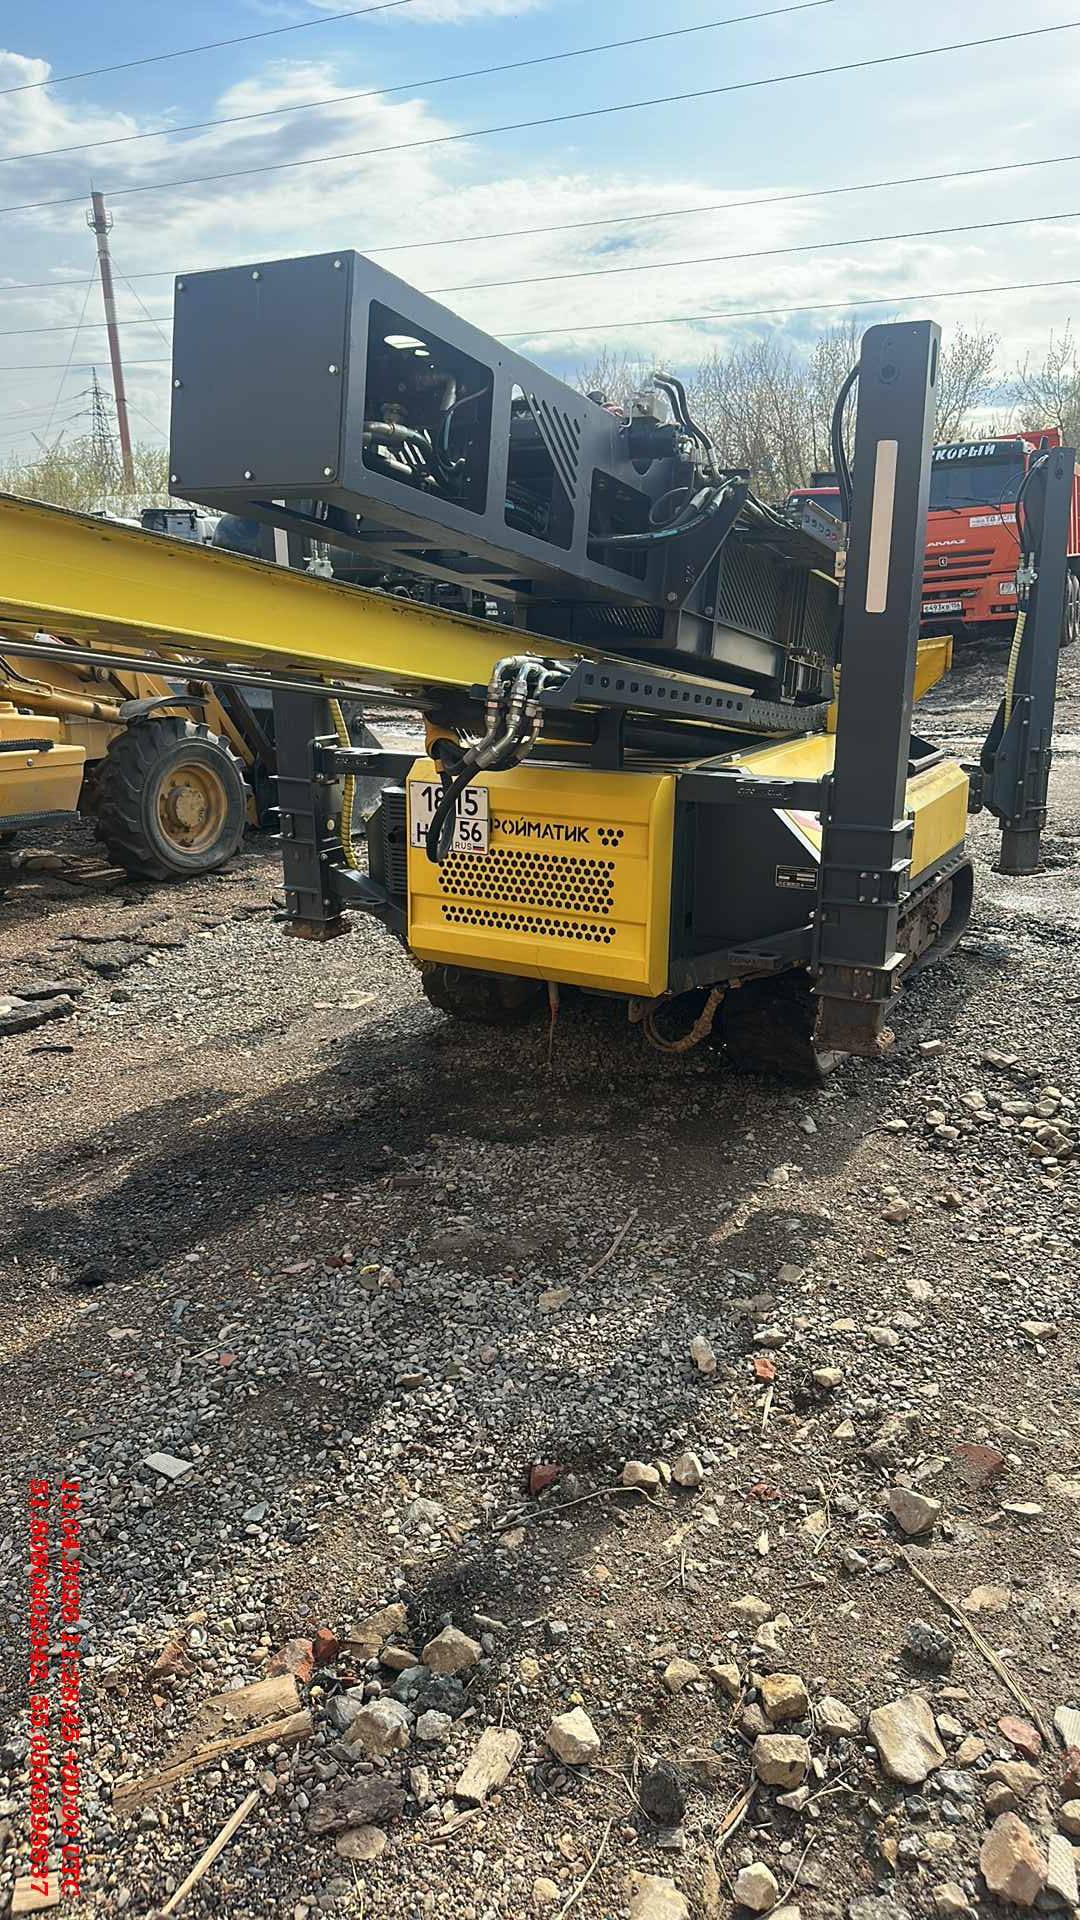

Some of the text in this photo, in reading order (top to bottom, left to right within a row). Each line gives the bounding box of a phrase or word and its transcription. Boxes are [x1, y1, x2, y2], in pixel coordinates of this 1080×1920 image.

[459, 820, 482, 843] 56
[489, 816, 590, 844] РОЙМАТИК
[455, 841, 473, 851] RUS
